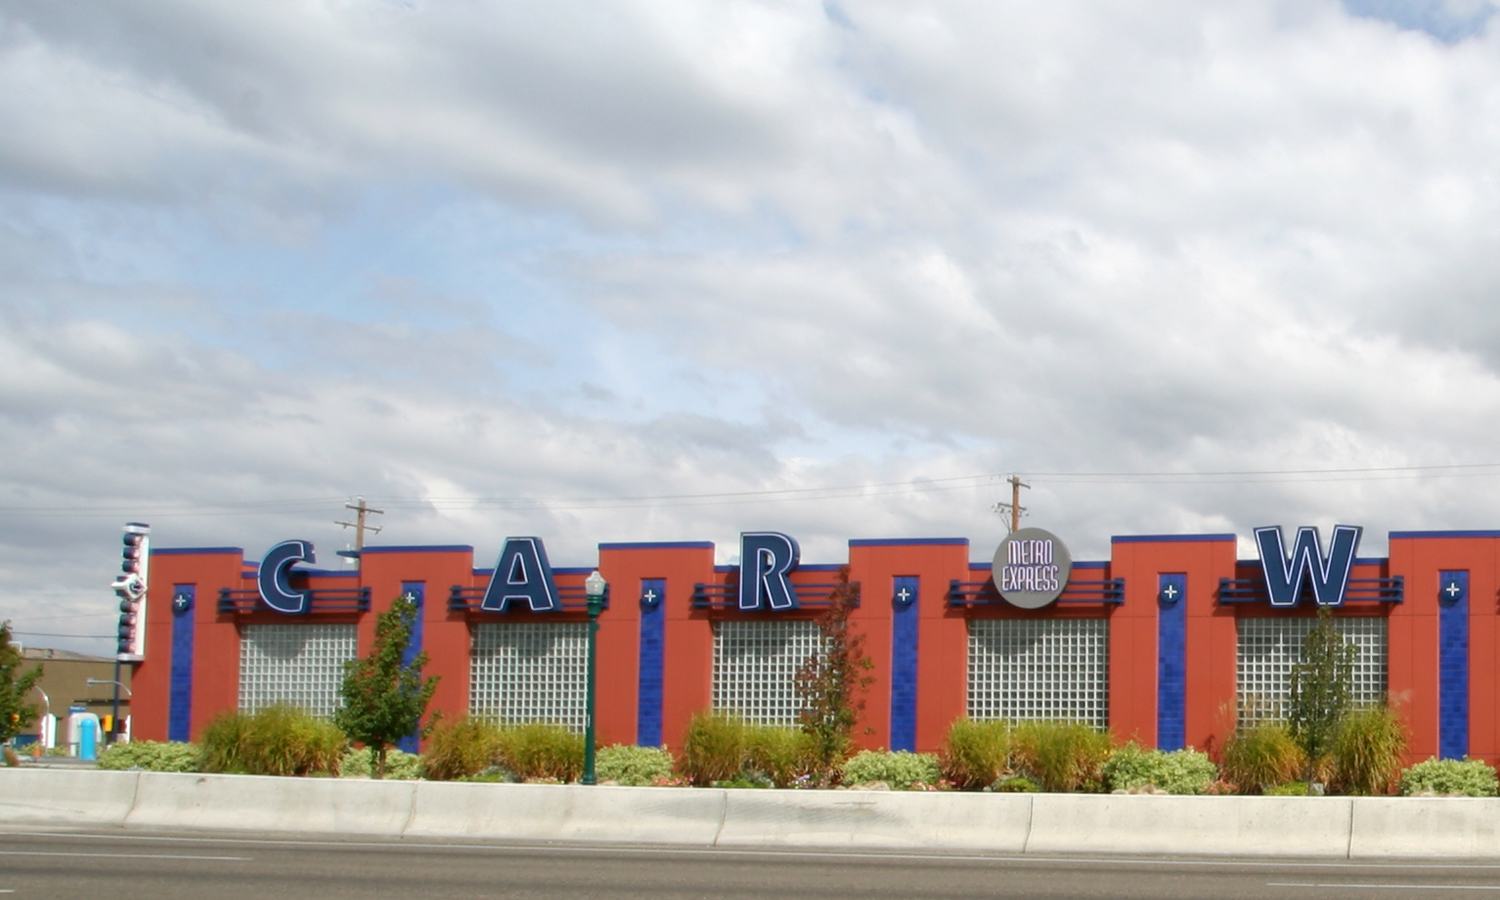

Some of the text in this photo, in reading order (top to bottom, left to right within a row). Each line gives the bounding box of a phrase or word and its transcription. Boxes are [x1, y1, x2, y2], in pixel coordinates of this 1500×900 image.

[1007, 538, 1053, 566] METRO
[257, 531, 802, 614] CAR
[1002, 564, 1059, 592] EXPRESS
